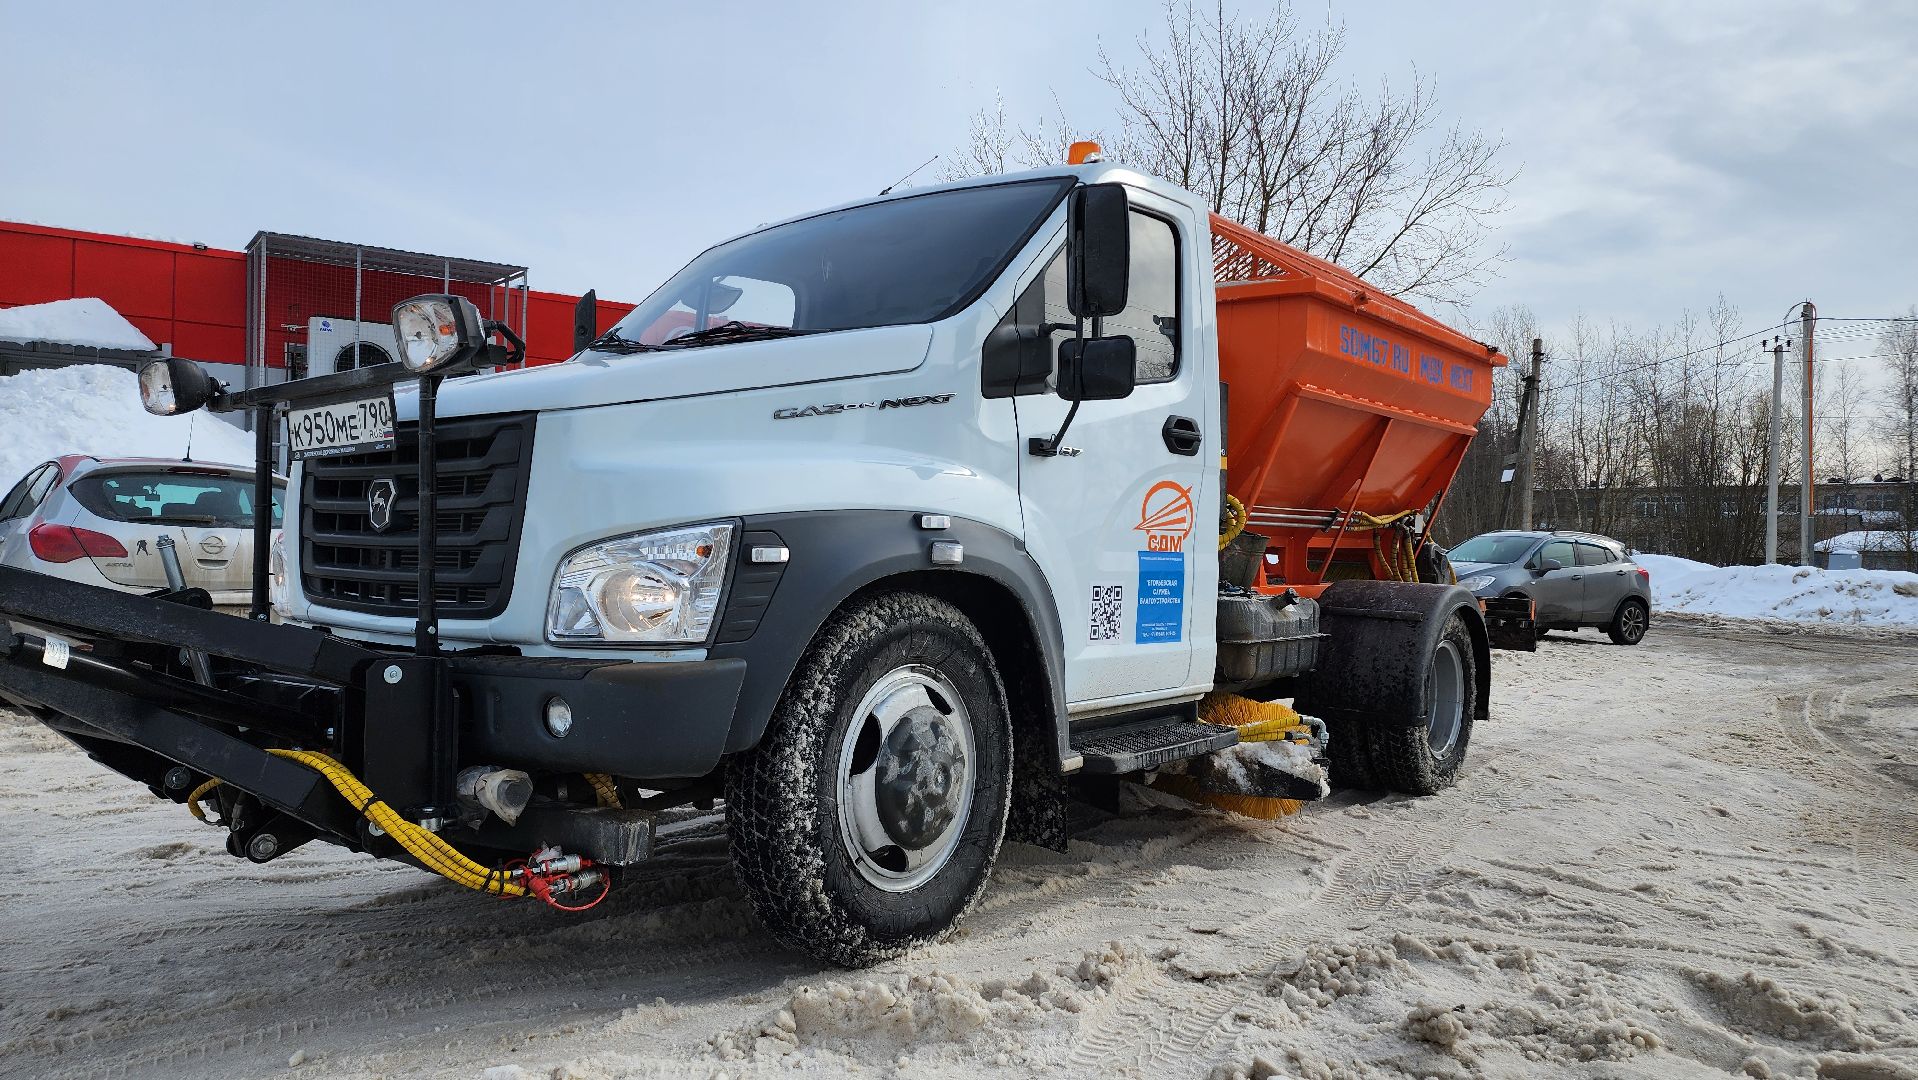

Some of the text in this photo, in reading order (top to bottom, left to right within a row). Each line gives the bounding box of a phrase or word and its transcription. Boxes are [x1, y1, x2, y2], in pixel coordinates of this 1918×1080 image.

[879, 392, 957, 410] NEXT
[359, 400, 388, 430] 790
[369, 428, 384, 440] RUS
